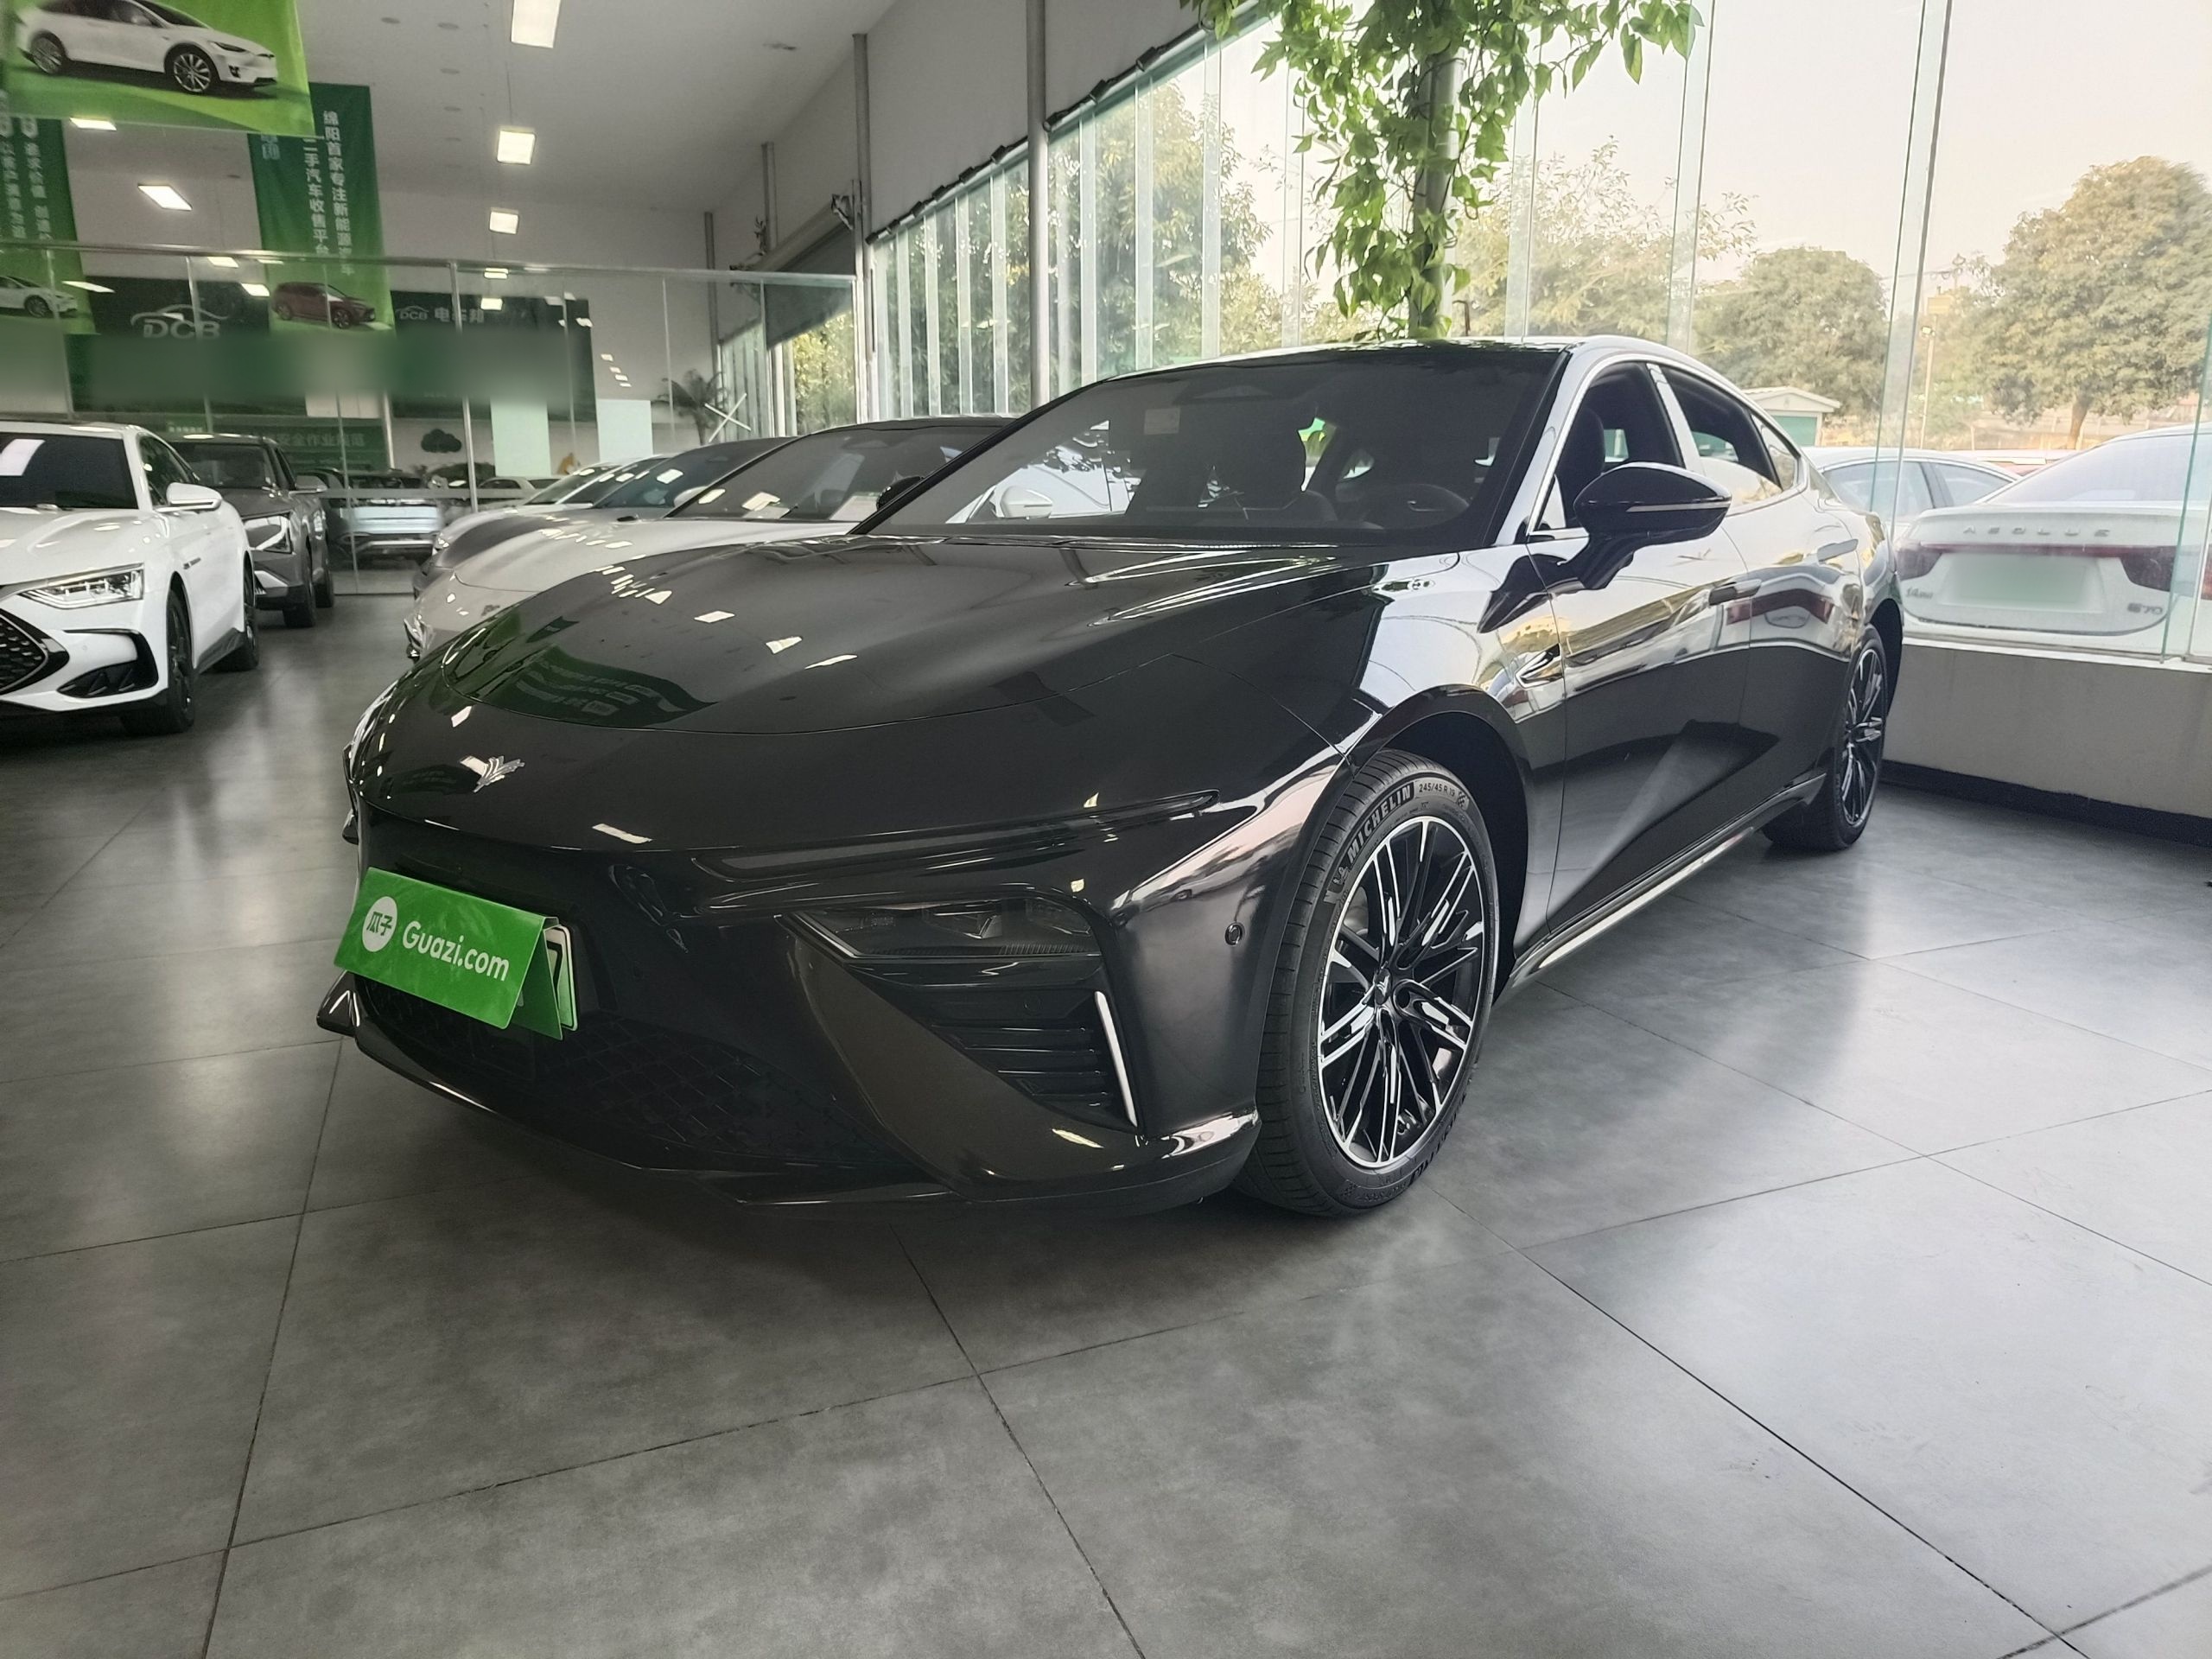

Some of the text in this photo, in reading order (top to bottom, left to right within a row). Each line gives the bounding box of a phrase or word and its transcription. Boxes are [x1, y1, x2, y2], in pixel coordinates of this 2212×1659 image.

[143, 318, 221, 340] DCB
[1419, 782, 1443, 793] 245/45
[1346, 785, 1412, 864] MICHELIN
[366, 911, 510, 982] 瓜子 Guazi.com
